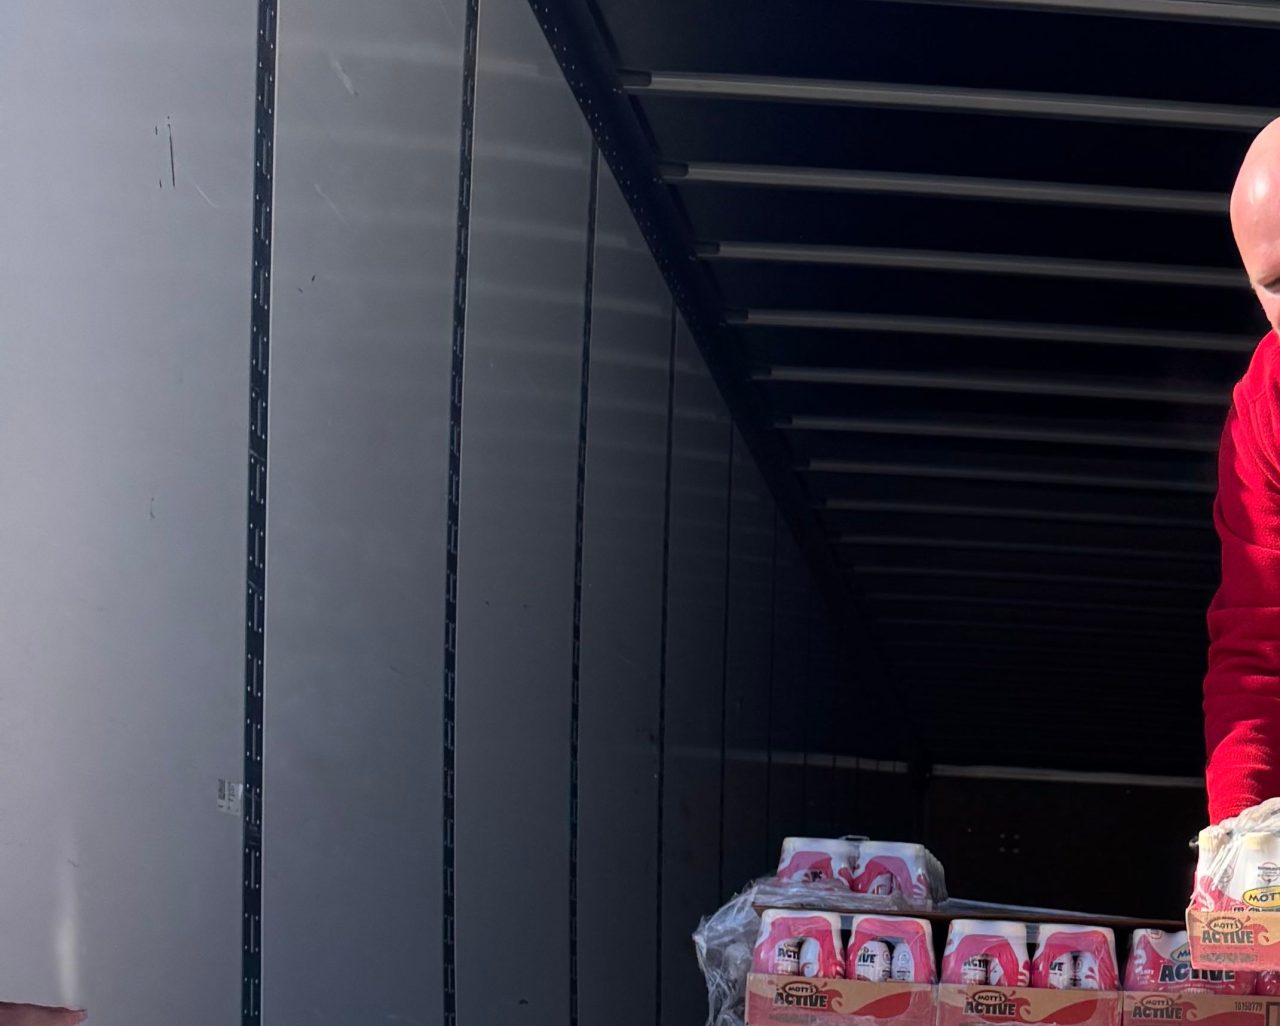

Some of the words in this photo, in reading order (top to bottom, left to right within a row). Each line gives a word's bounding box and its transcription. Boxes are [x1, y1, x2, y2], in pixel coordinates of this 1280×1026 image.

[1202, 929, 1254, 944] ACTIVE
[1158, 962, 1236, 984] ACTIVE
[774, 992, 829, 1008] ACTIVE
[963, 1002, 1017, 1016] ACTIVE
[1132, 1006, 1183, 1019] ACTIVE
